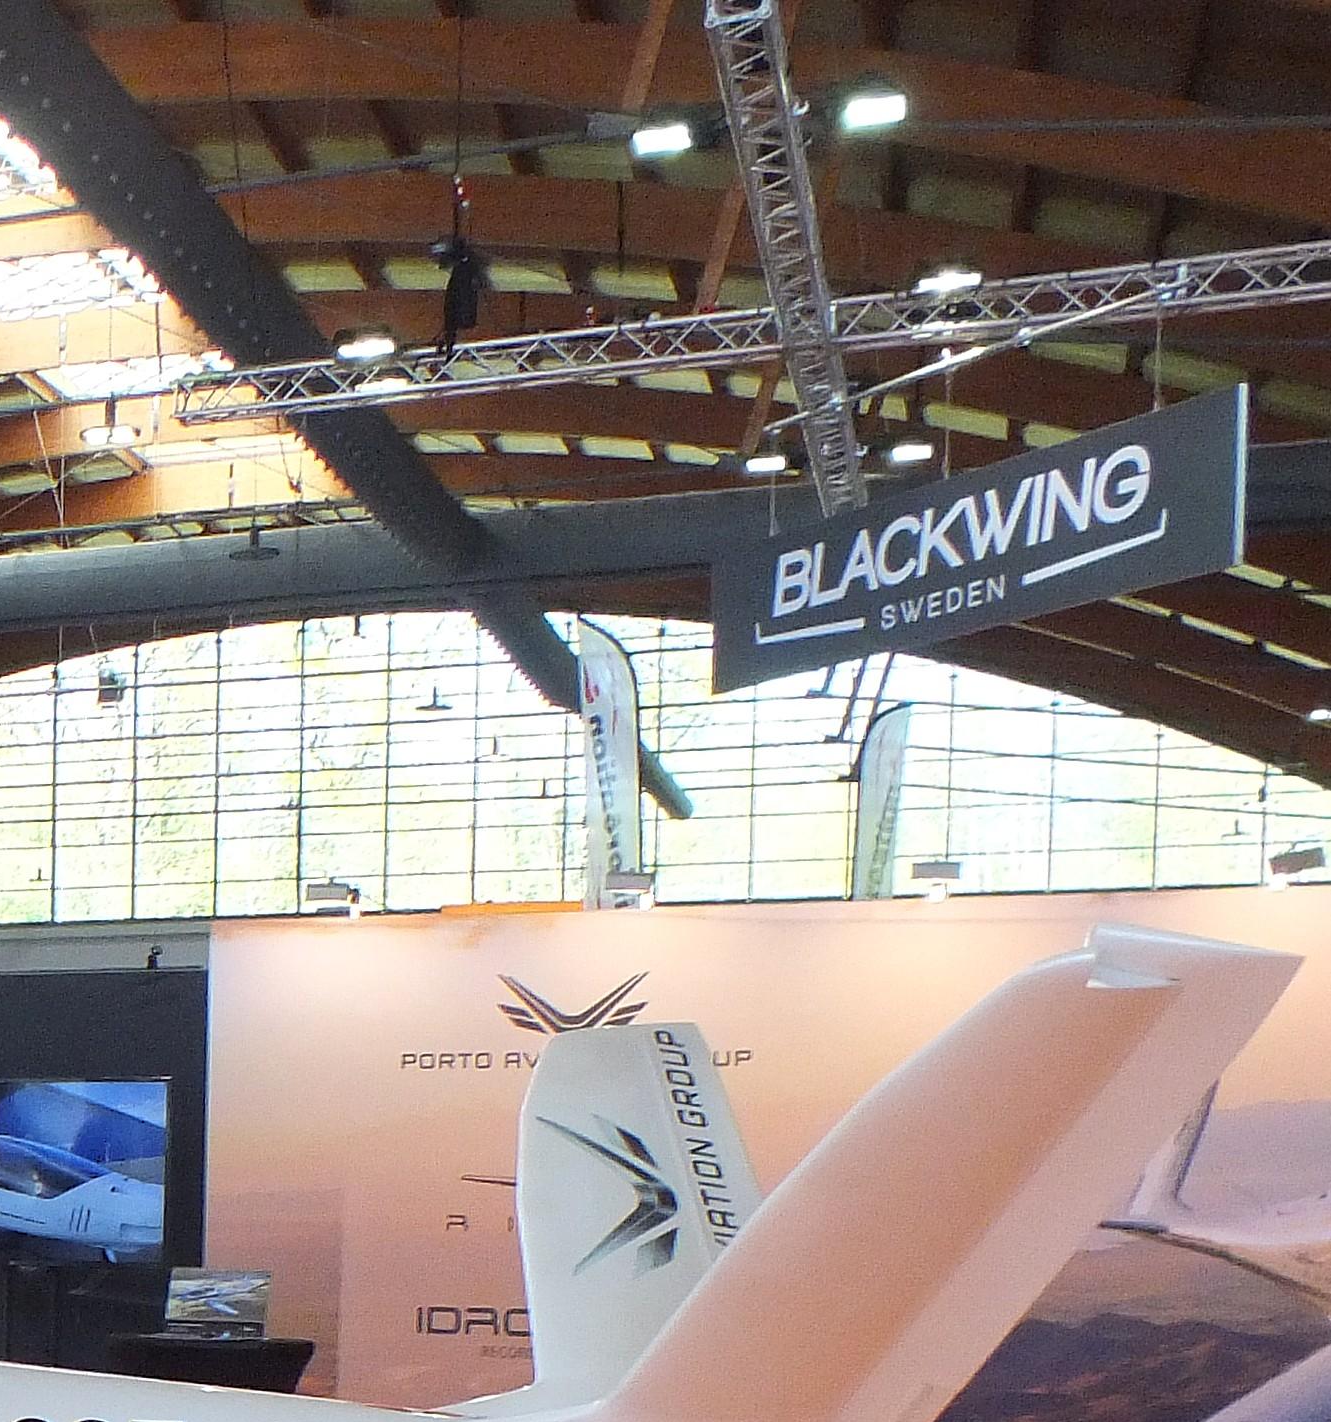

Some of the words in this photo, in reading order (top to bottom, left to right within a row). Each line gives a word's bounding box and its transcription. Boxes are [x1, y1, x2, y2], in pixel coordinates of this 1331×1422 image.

[772, 444, 1151, 618] BLACKWING
[880, 574, 1007, 630] SWEDEN
[401, 1051, 492, 1070] PORTO
[654, 1030, 709, 1127] GROUP
[686, 1138, 739, 1246] IATION
